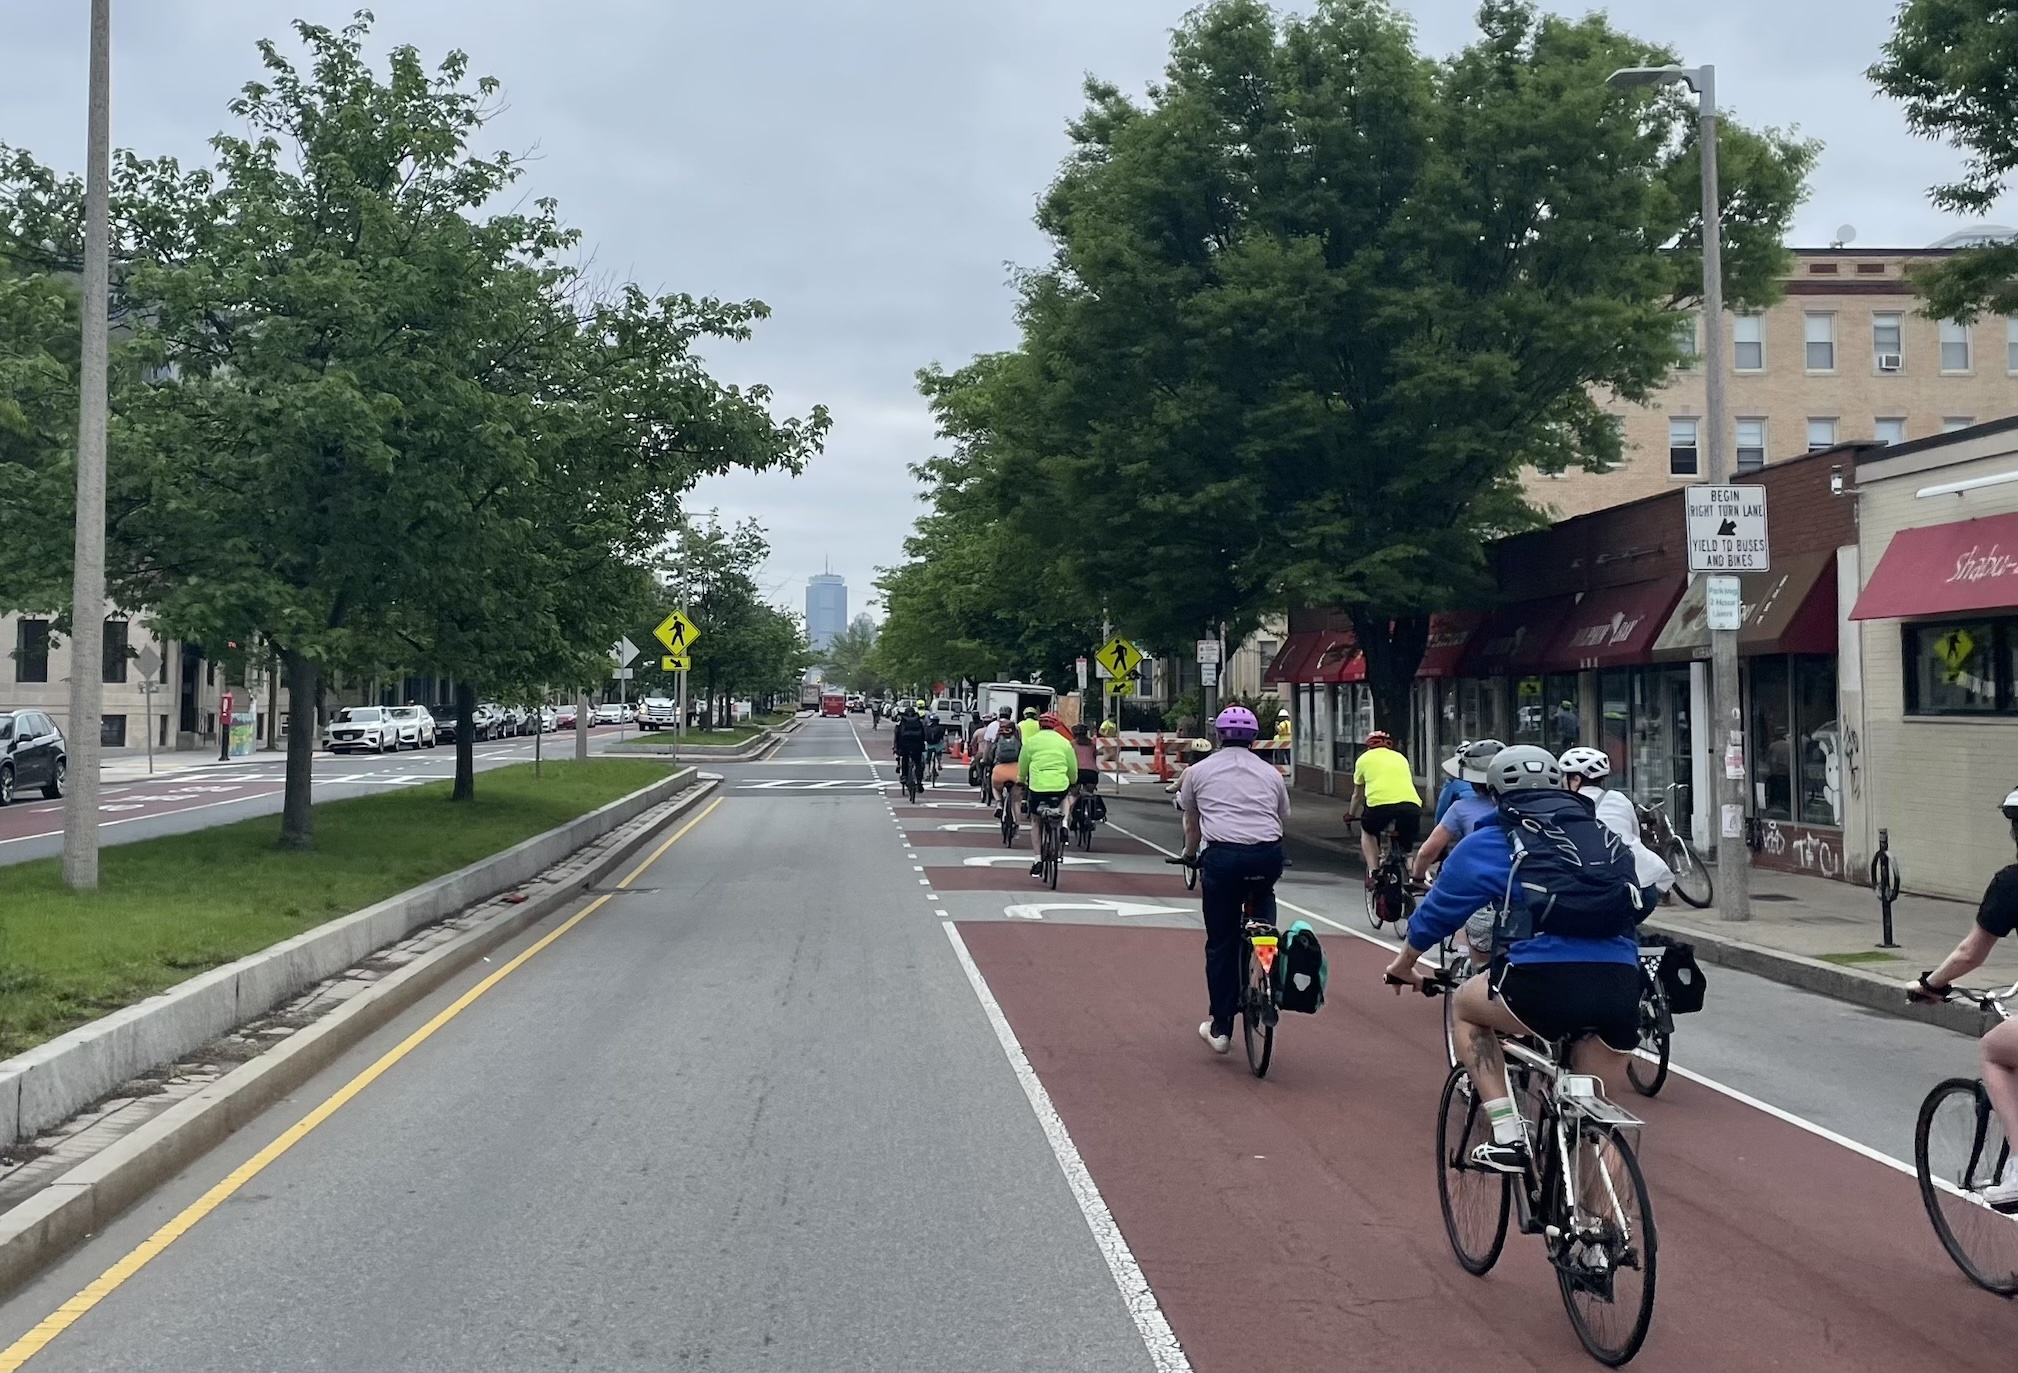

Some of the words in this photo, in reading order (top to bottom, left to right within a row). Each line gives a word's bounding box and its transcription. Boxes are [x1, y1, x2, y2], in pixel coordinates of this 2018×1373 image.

[1711, 490, 1740, 502] BEGIN
[1690, 504, 1713, 517] RIGHT
[1718, 505, 1740, 517] TURN
[1743, 504, 1763, 517] LANE
[1693, 540, 1718, 552] YIELD
[1722, 540, 1733, 552] TO
[1736, 540, 1765, 552] BUSES
[1707, 555, 1724, 567] AND
[1727, 555, 1754, 567] BIKES
[1946, 544, 2018, 583] Shabu-
[1710, 598, 1714, 606] 2
[1716, 598, 1735, 606] Hour
